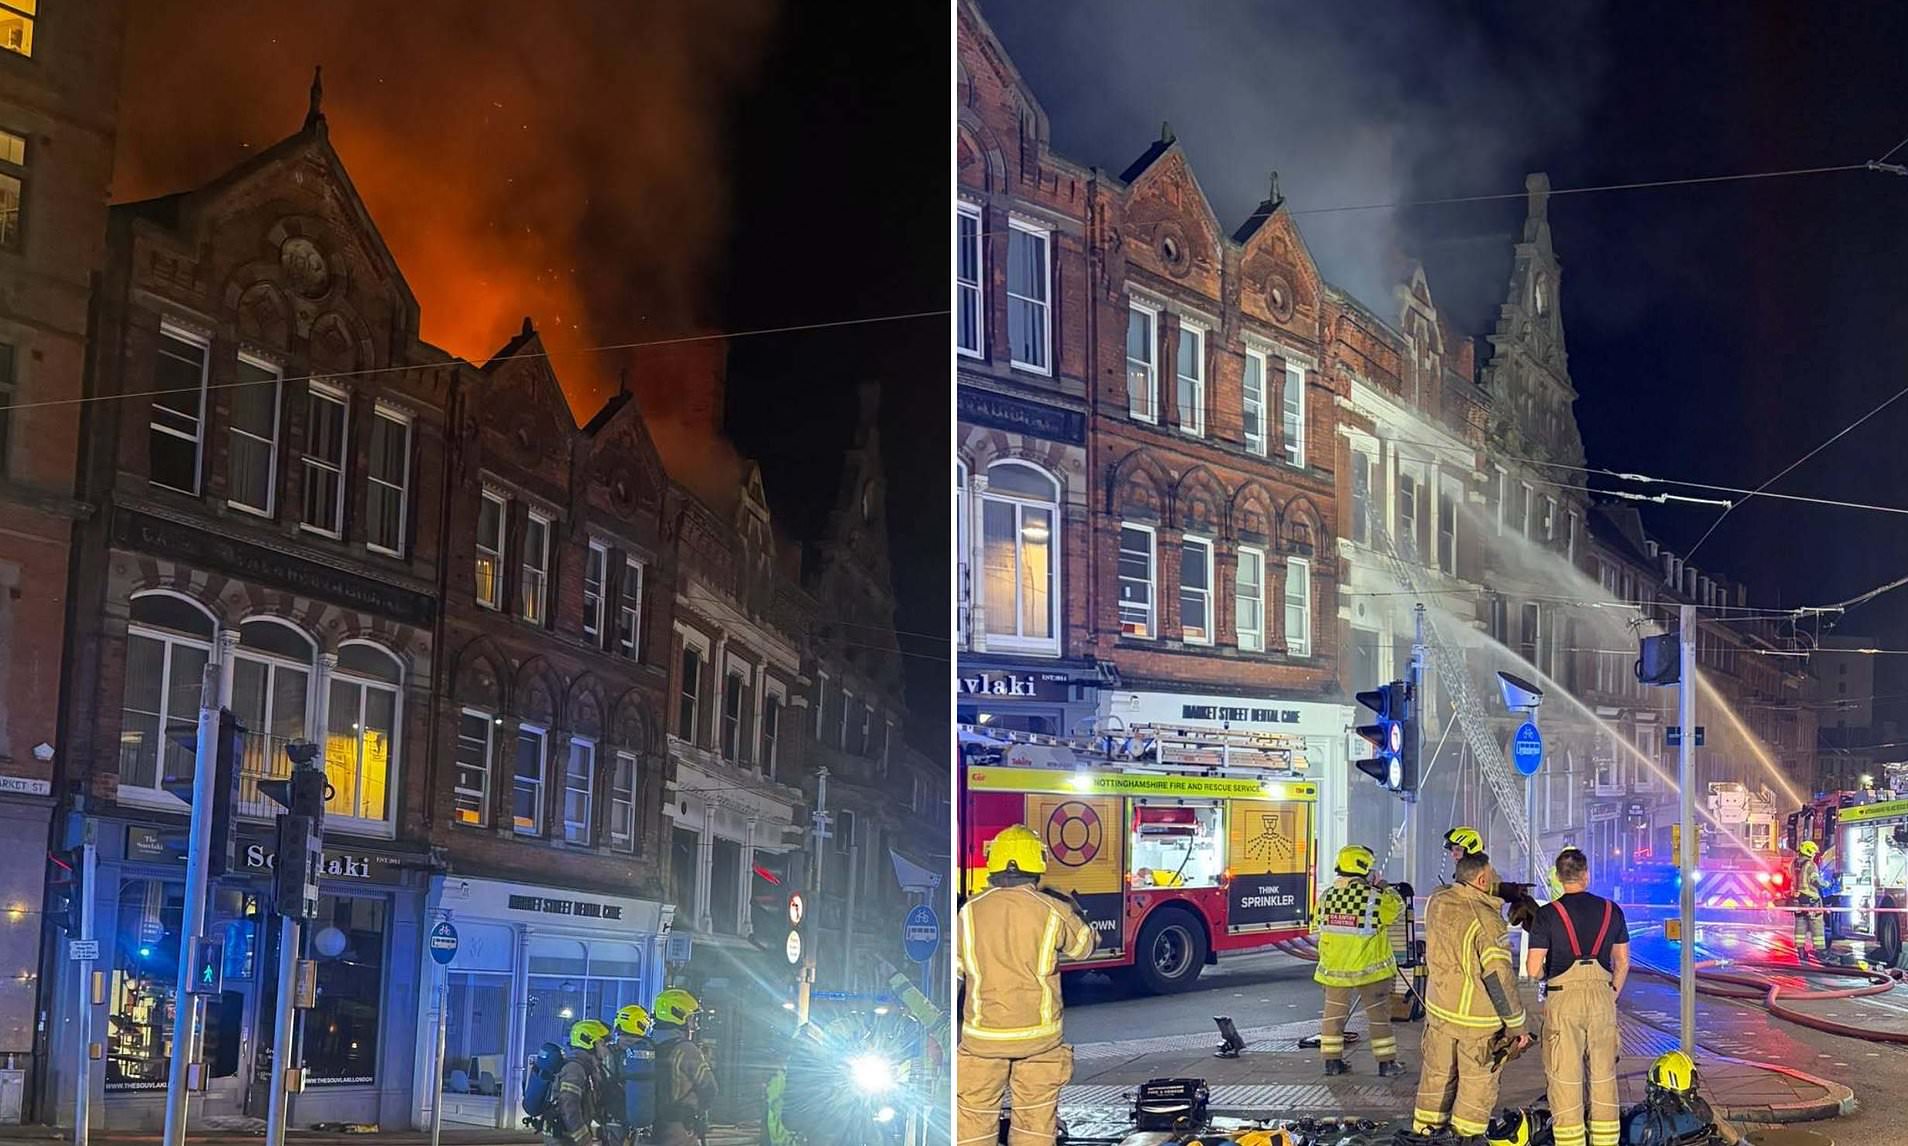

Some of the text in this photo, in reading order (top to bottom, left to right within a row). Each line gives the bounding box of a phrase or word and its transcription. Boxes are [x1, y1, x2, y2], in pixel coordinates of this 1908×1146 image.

[1182, 704, 1218, 720] MARKET
[1218, 706, 1249, 721] STREET
[1251, 708, 1280, 723] DENTAL
[1094, 779, 1260, 793] NOTTINGHAMSHIRE FIRE AND RESCUE SERVICE
[1258, 885, 1280, 895] THINK
[1241, 894, 1295, 908] SPRINKLER
